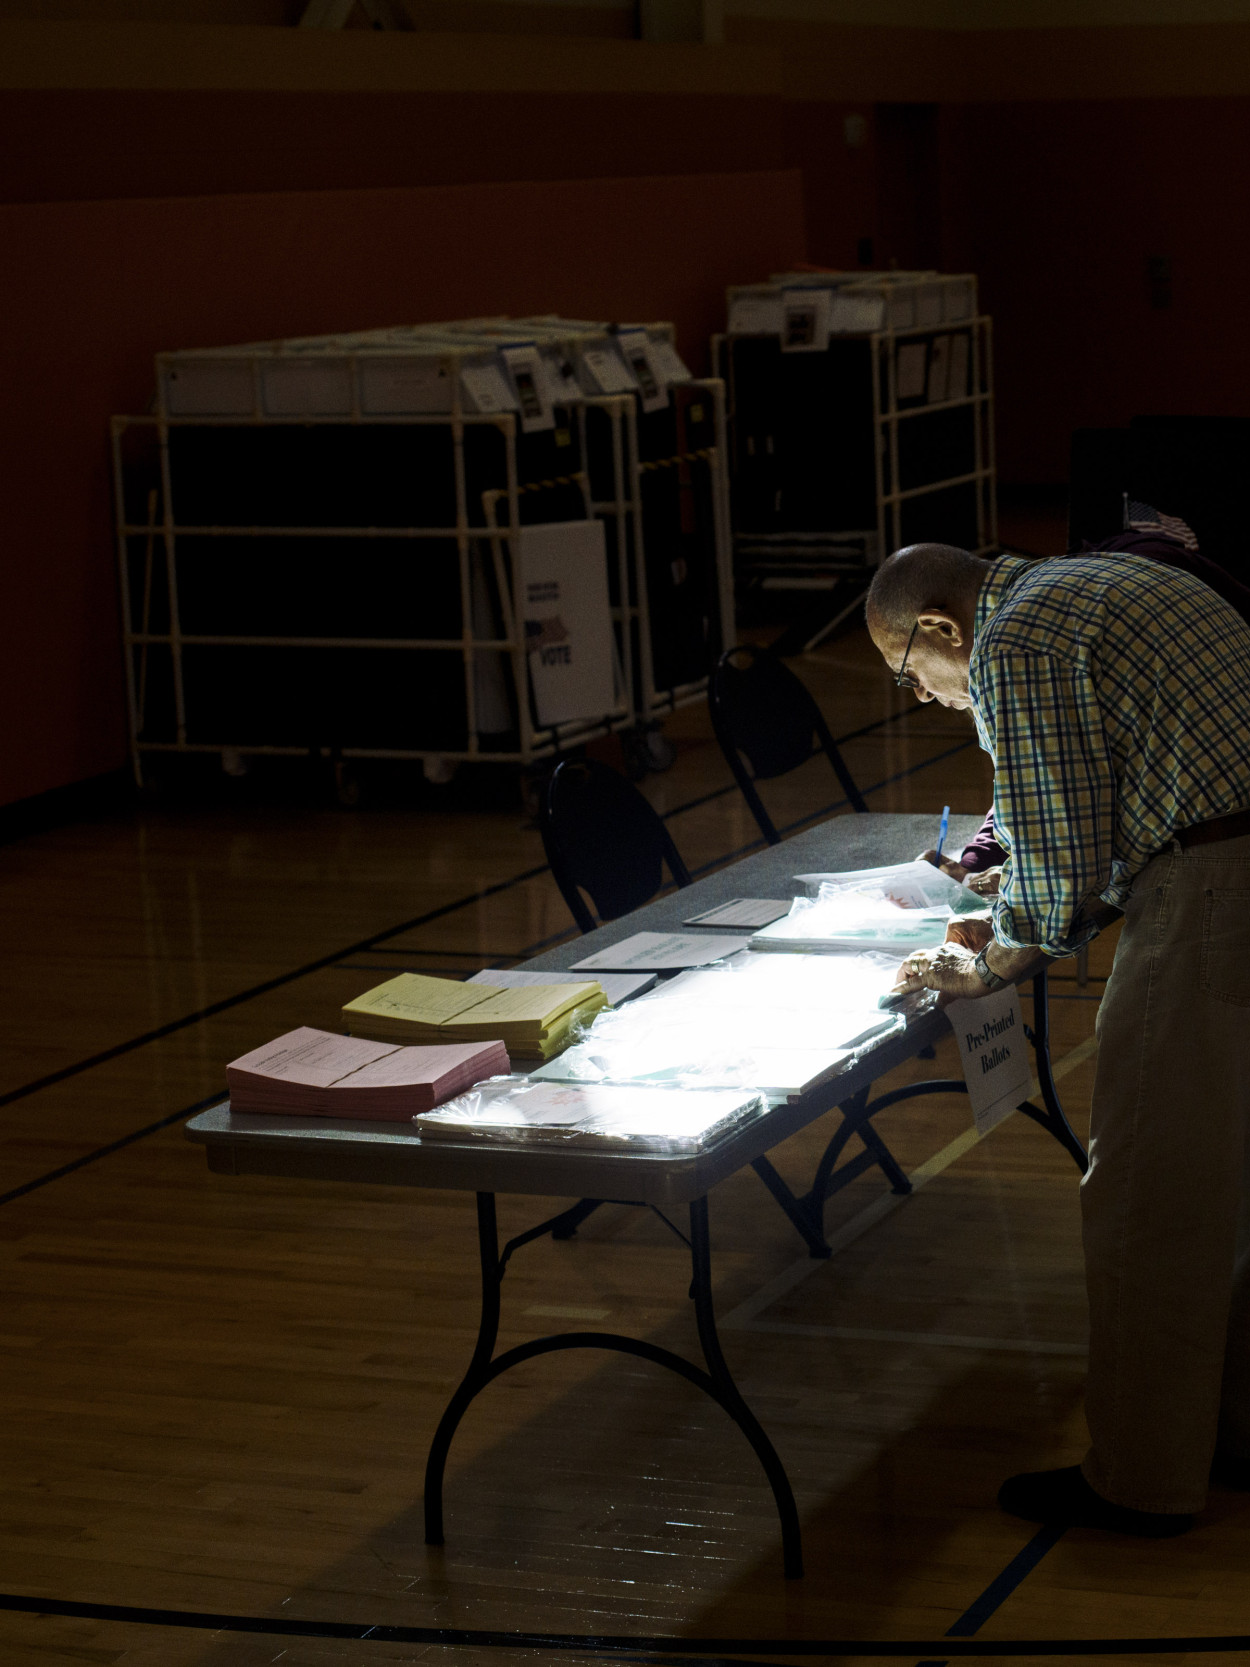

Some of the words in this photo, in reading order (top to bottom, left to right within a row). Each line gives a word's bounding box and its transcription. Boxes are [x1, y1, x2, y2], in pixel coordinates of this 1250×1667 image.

[542, 646, 571, 666] VOTE
[966, 1008, 1015, 1052] Pre-Printed
[981, 1045, 1011, 1074] Ballots
